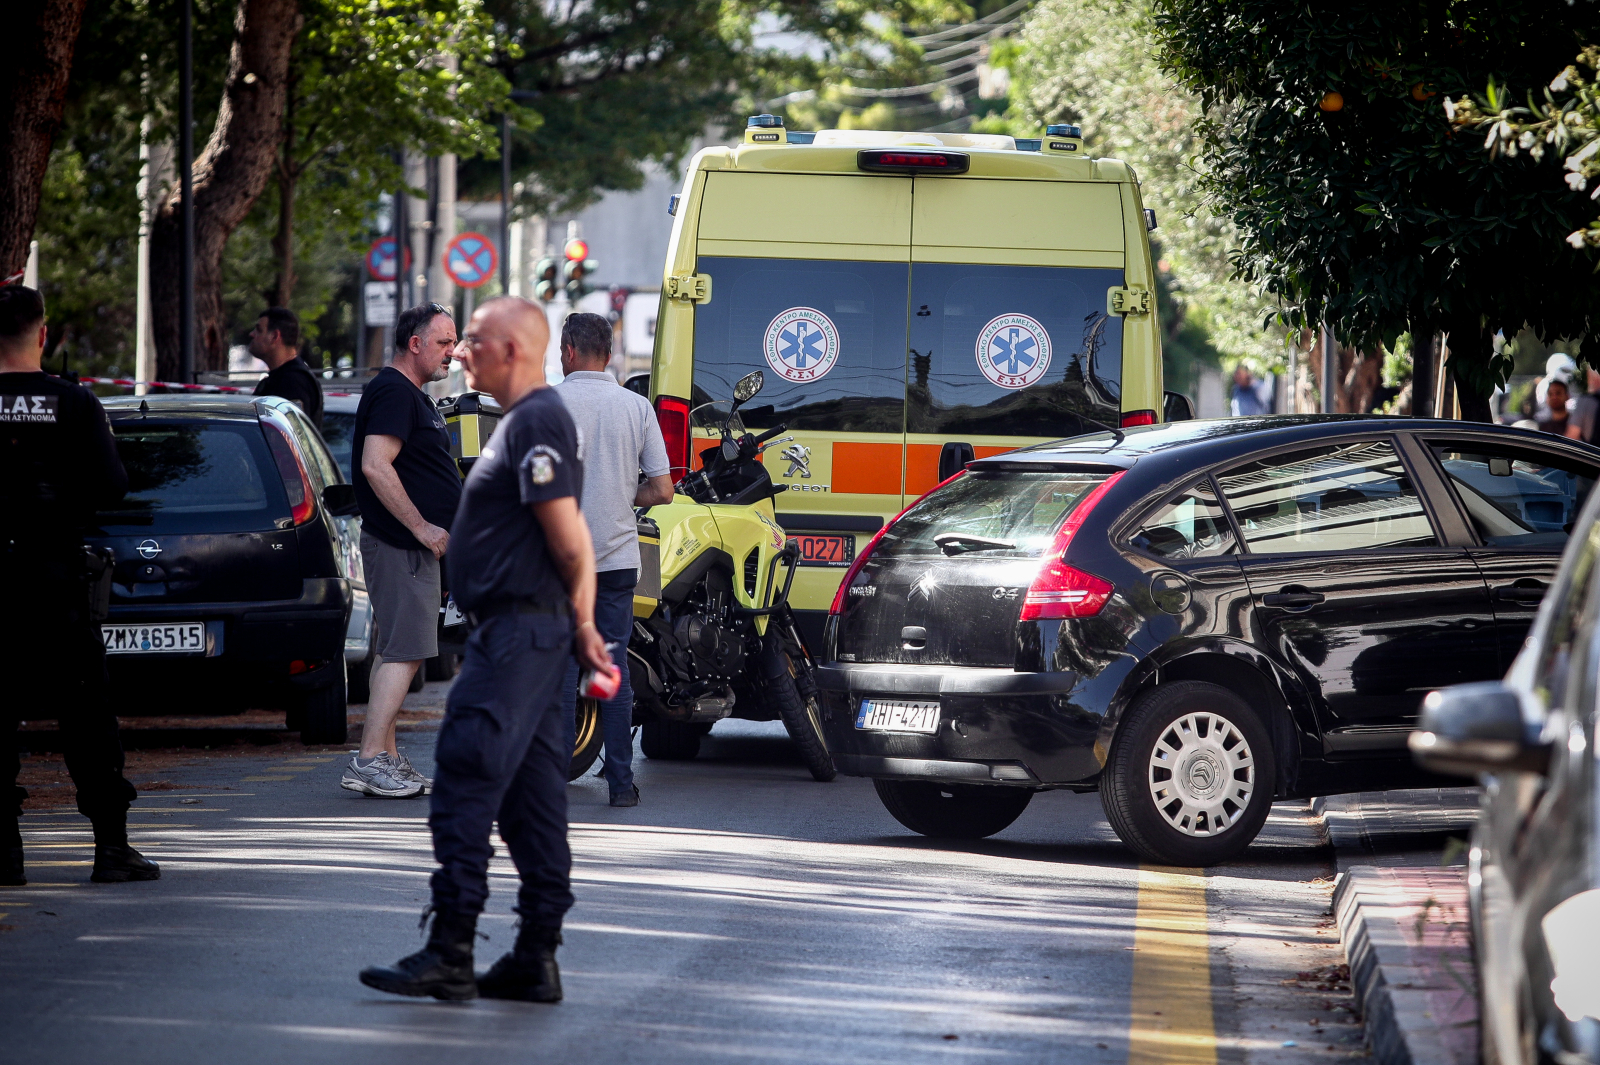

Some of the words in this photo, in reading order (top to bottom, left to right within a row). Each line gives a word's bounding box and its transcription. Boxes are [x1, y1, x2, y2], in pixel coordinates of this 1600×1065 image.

[773, 312, 797, 332] ΚΕΝΤΡΟ
[799, 311, 826, 327] ΑΜΕΣΗΣ
[824, 325, 835, 364] ΒΟΗΘΕΙΑΣ
[985, 318, 1010, 338] ΚΕΝΤΡΟ
[1011, 317, 1039, 333] ΑΜΕΣΗΣ
[1036, 331, 1047, 371] ΒΟΗΘΕΙΑΣ
[12, 414, 56, 422] ΑΣΤΥΝΟΜΙΑ
